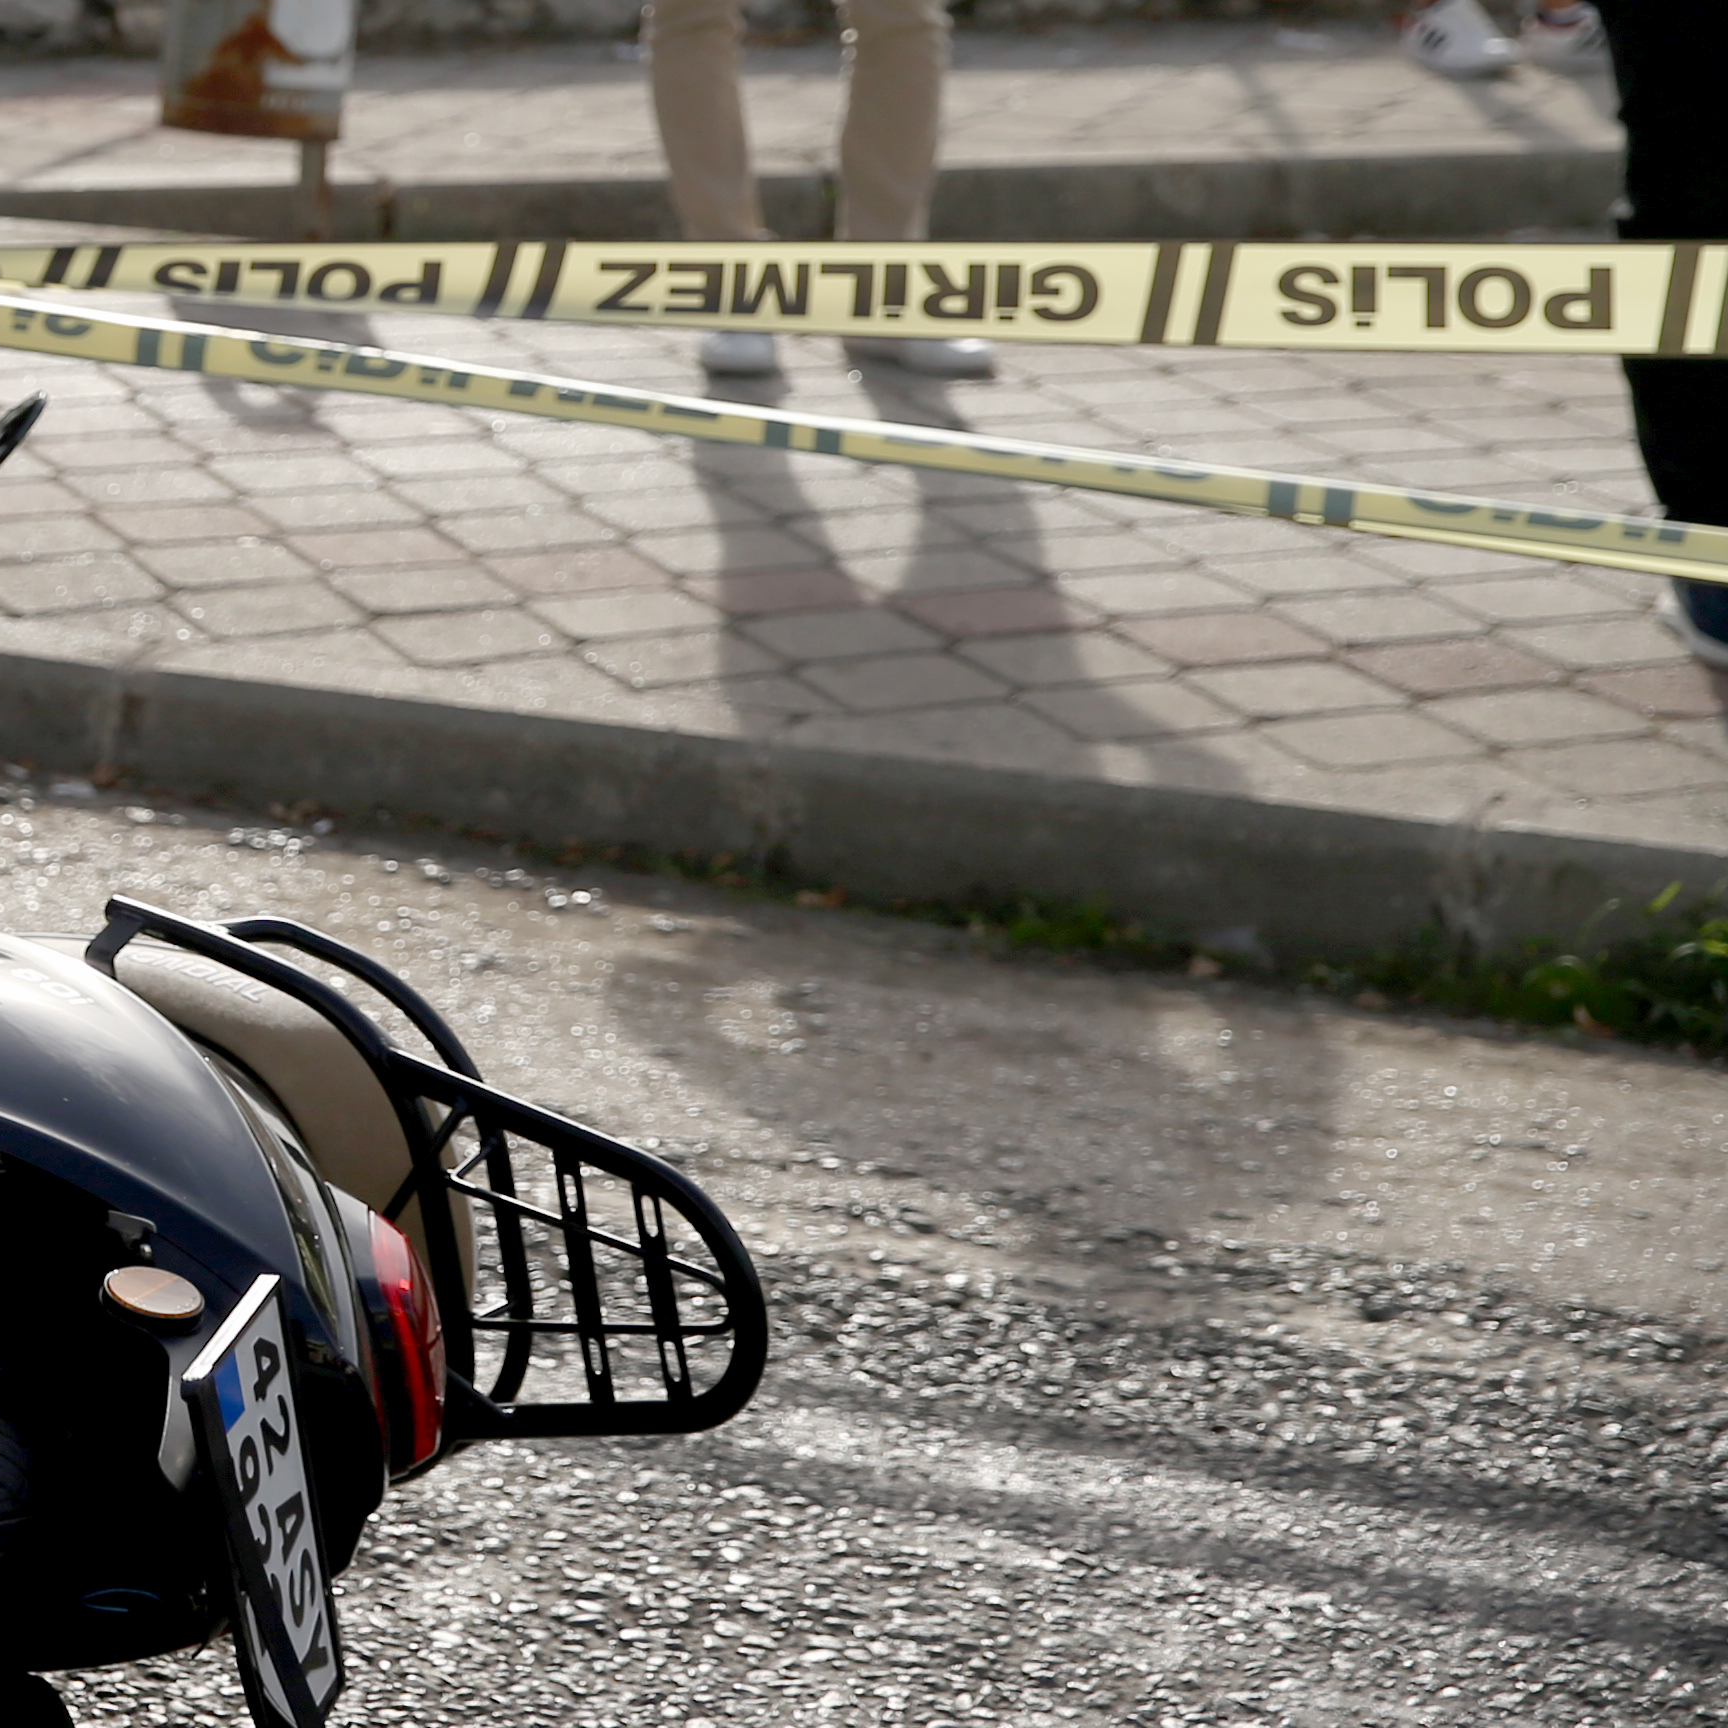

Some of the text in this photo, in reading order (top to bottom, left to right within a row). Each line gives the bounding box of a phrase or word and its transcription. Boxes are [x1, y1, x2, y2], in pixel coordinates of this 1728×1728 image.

[595, 262, 1099, 322] GİRİLMEZ
[1279, 266, 1611, 330] POLİS
[114, 951, 271, 1004] ONDIAL
[253, 1337, 291, 1477] 42
[275, 1490, 329, 1677] ASY
